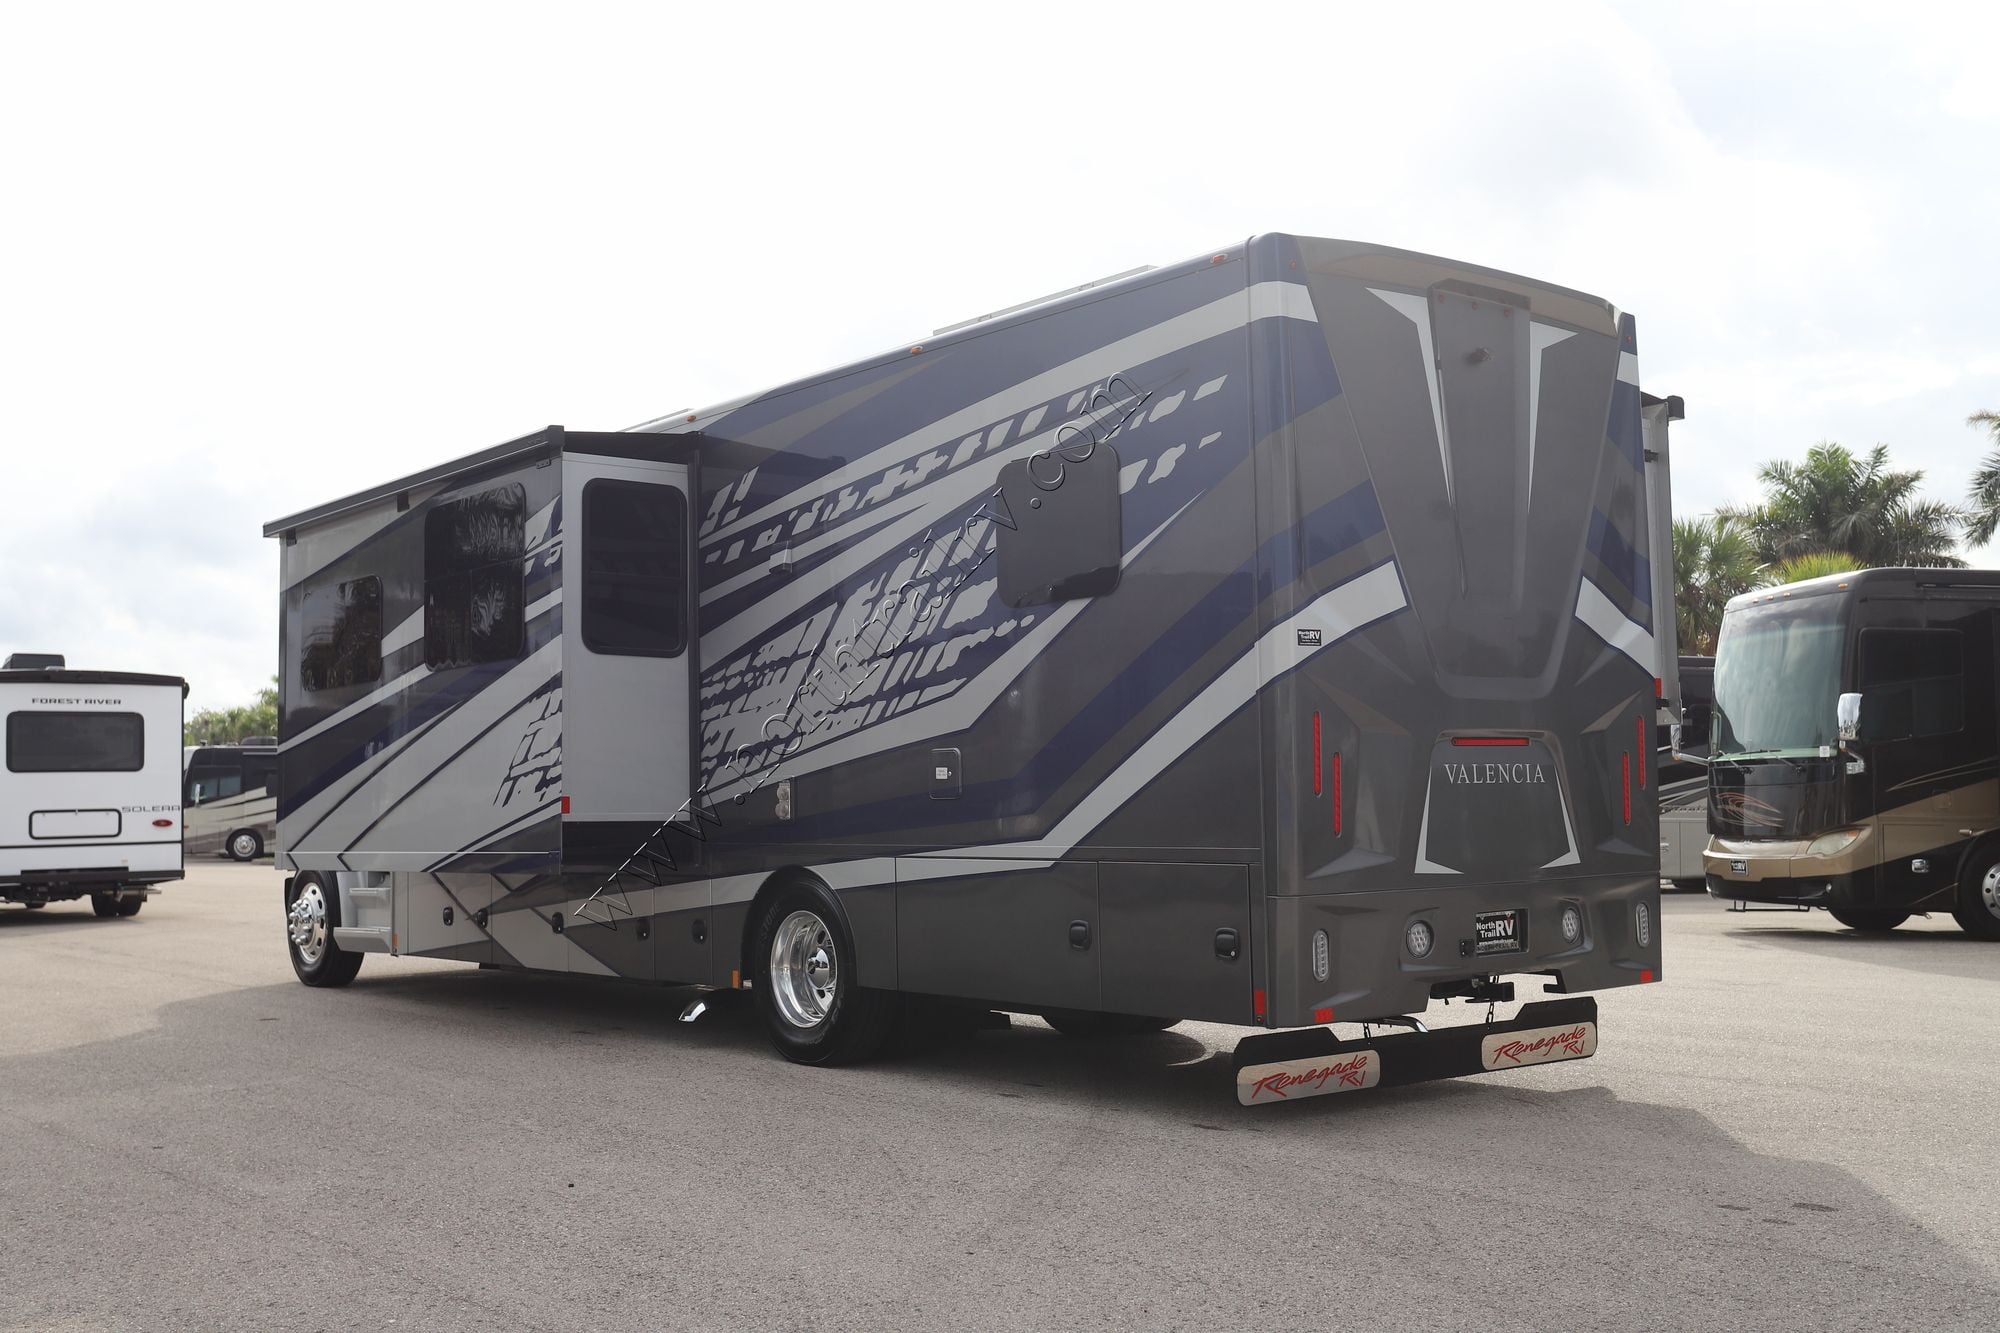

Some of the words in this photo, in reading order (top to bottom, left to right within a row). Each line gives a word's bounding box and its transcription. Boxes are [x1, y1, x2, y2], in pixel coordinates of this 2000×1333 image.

[1309, 631, 1320, 639] RV
[31, 697, 82, 705] FOREST
[1444, 763, 1546, 784] VALENCIA
[121, 804, 181, 813] SOLERA
[1476, 921, 1496, 930] North
[1495, 919, 1514, 937] RV
[1480, 929, 1496, 938] Trail
[1493, 1025, 1586, 1065] Renegade
[1562, 1040, 1585, 1055] RV
[1251, 1054, 1368, 1099] Renegade
[1339, 1070, 1366, 1088] RV
